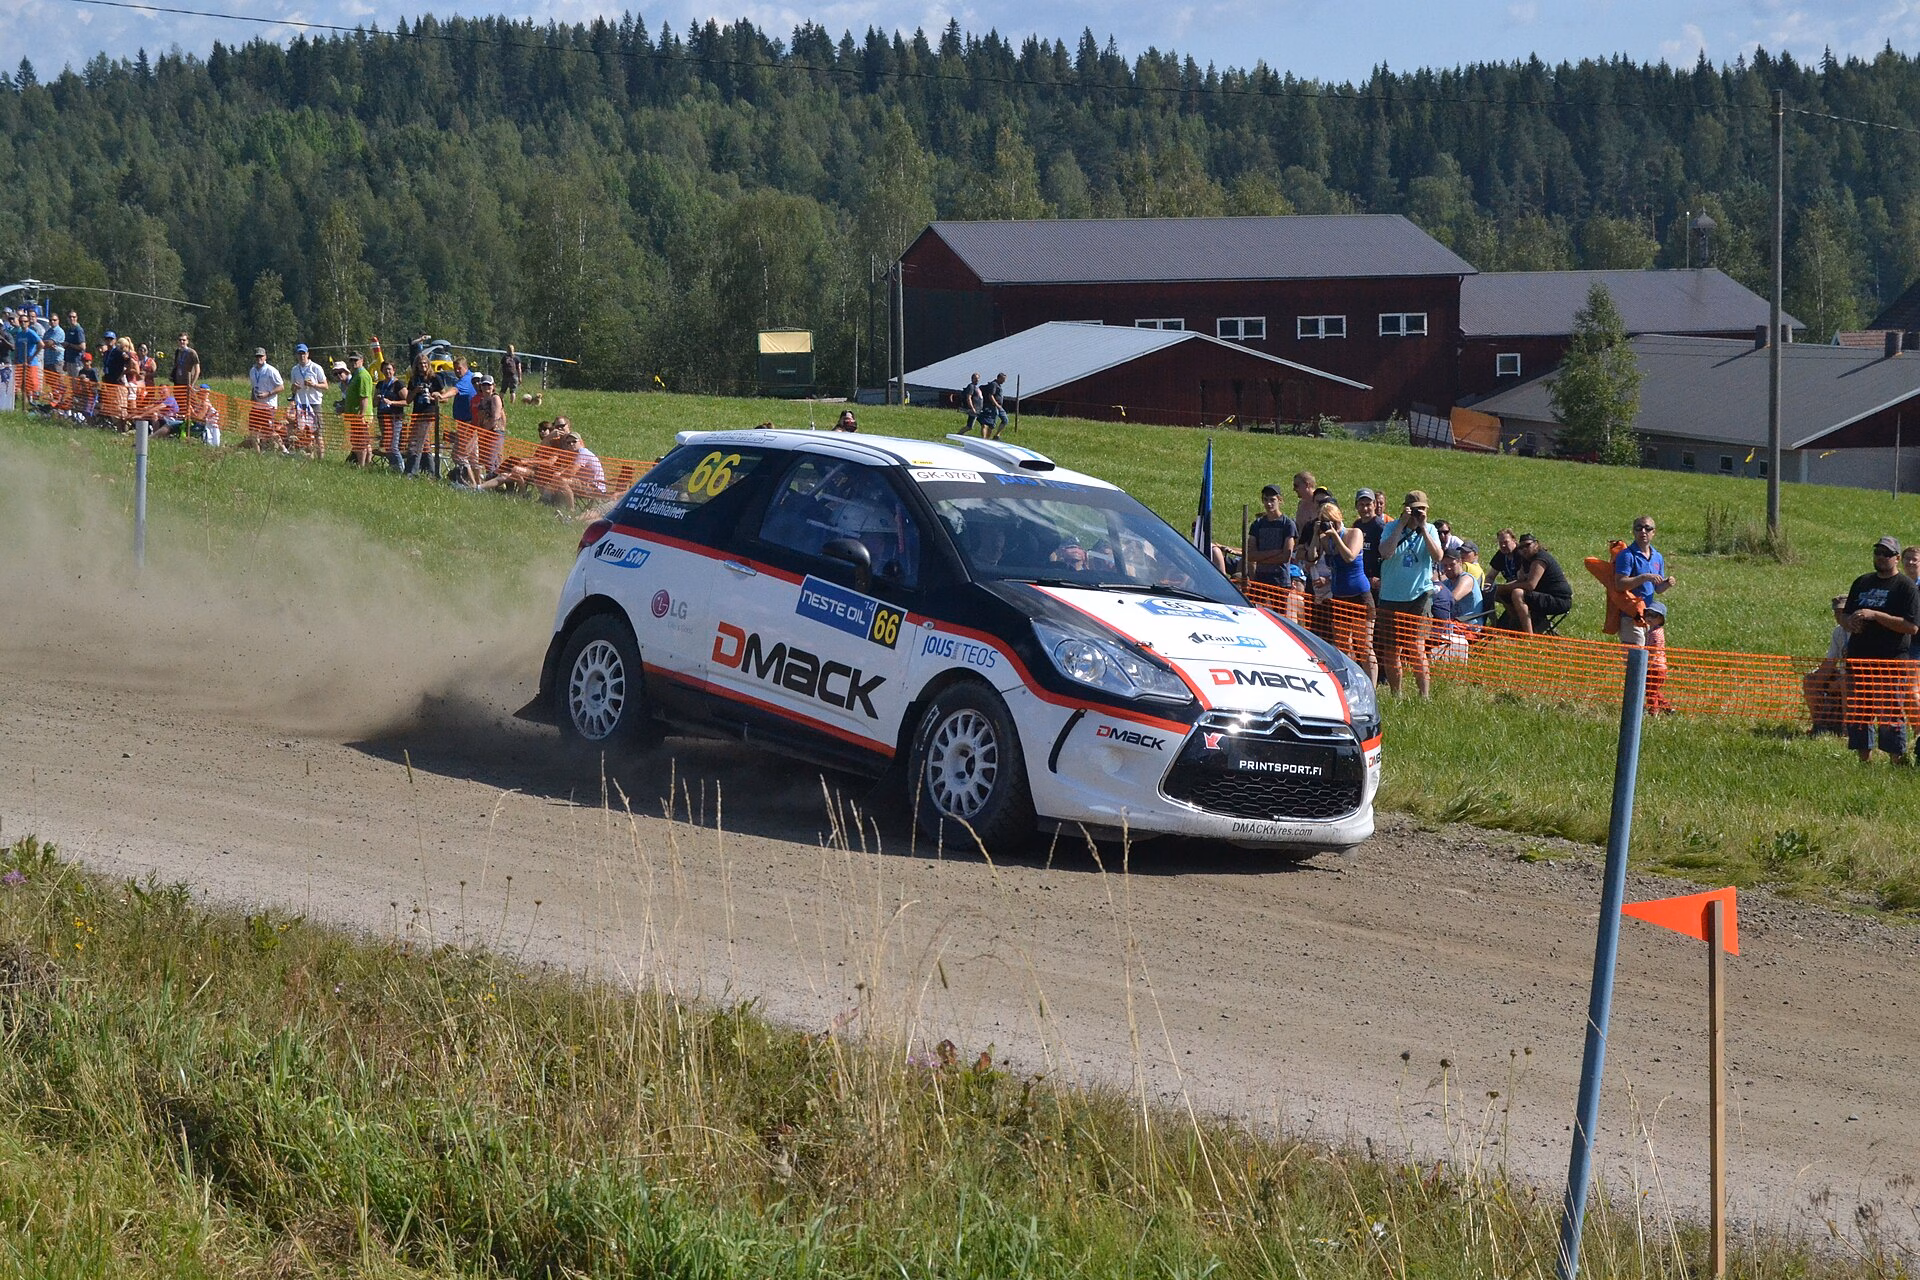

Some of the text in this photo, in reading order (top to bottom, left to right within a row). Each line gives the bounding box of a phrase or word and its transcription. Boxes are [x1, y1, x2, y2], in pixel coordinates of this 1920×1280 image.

[688, 451, 741, 497] 66
[916, 471, 977, 480] GK-0767
[603, 542, 648, 566] Ralli SM
[670, 598, 688, 620] LG
[801, 589, 847, 618] NESTE
[846, 605, 866, 625] OIL
[873, 609, 900, 645] 66
[1201, 633, 1265, 647] Ralli SM
[1239, 759, 1323, 776] PRINTSPORT.FI
